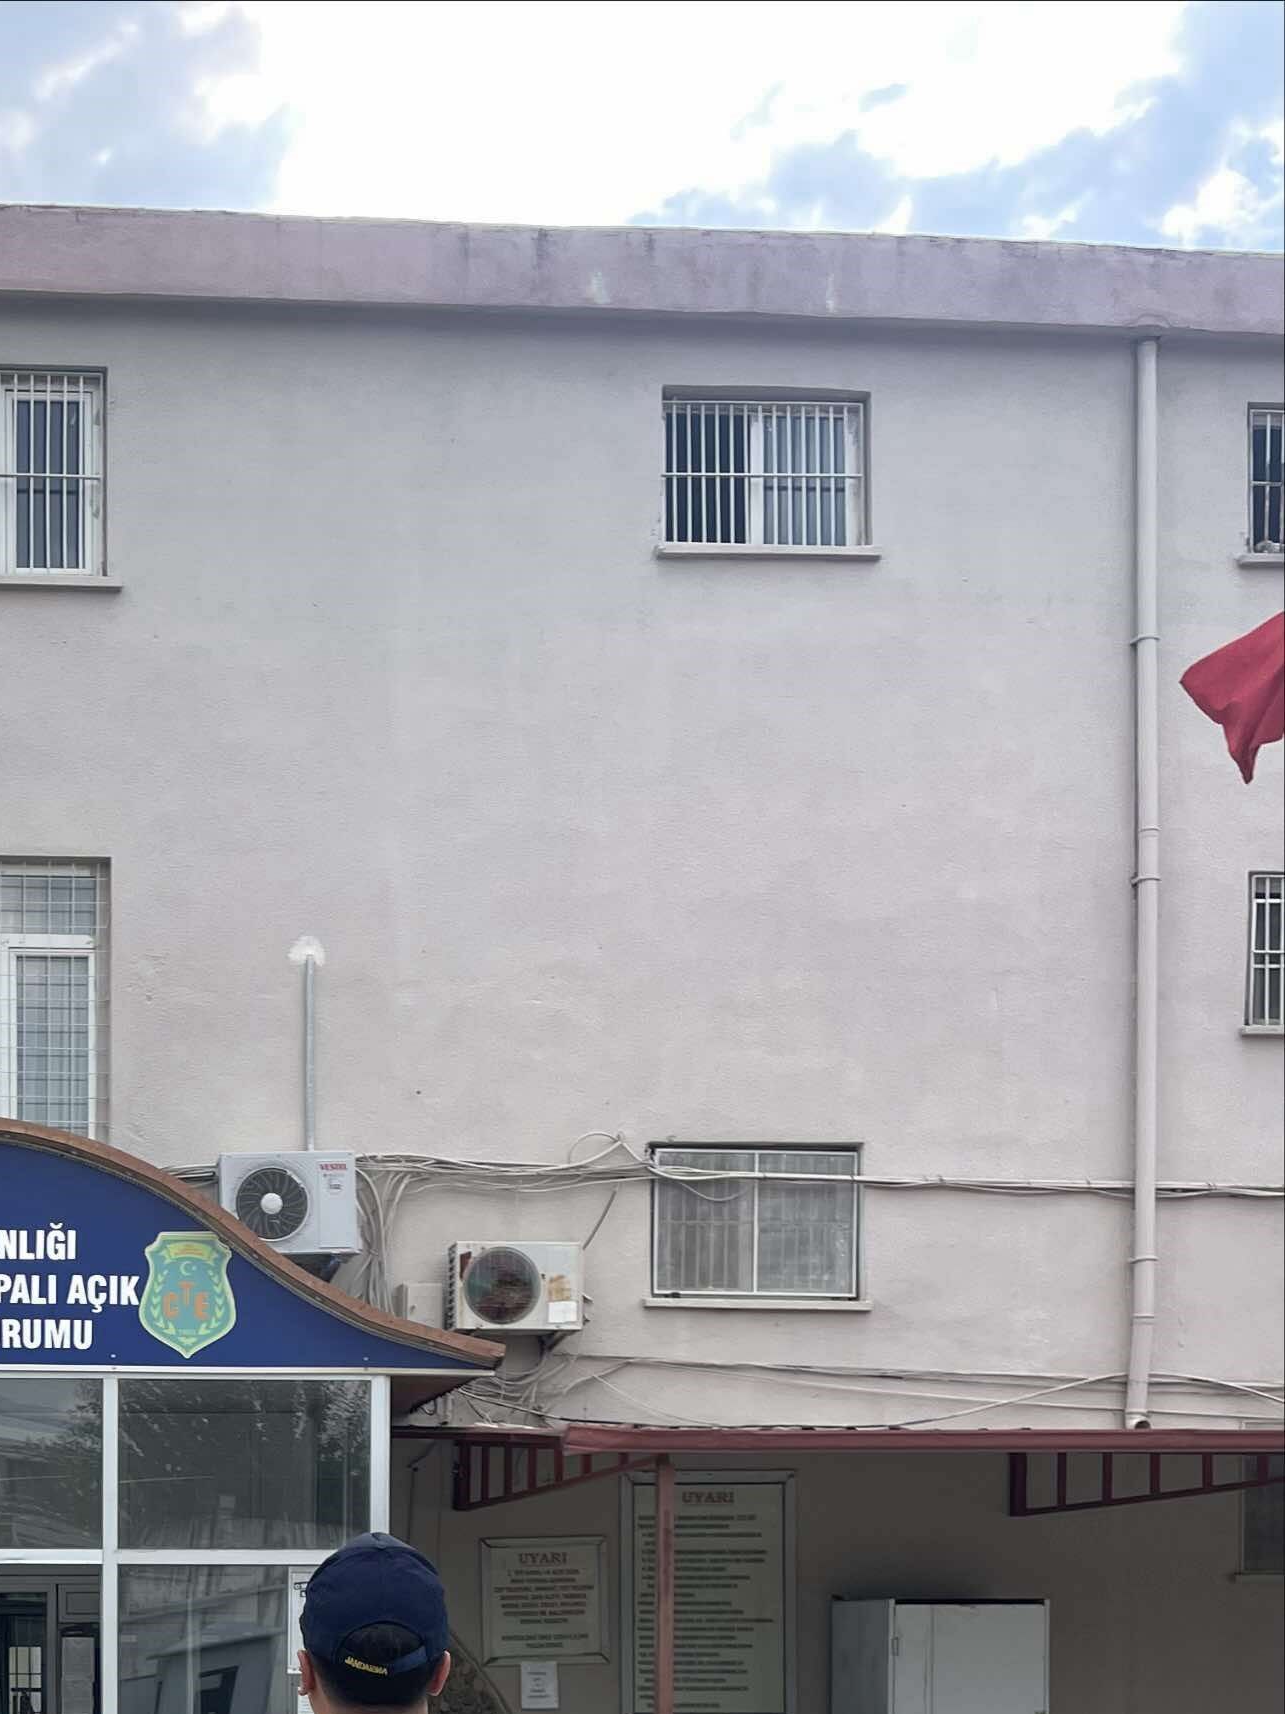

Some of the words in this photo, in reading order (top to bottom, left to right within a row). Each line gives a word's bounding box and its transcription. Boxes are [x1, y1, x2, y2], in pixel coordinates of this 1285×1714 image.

[67, 1274, 140, 1313] AÇIK
[682, 1491, 735, 1504] UYARI
[518, 1552, 567, 1565] UYARI
